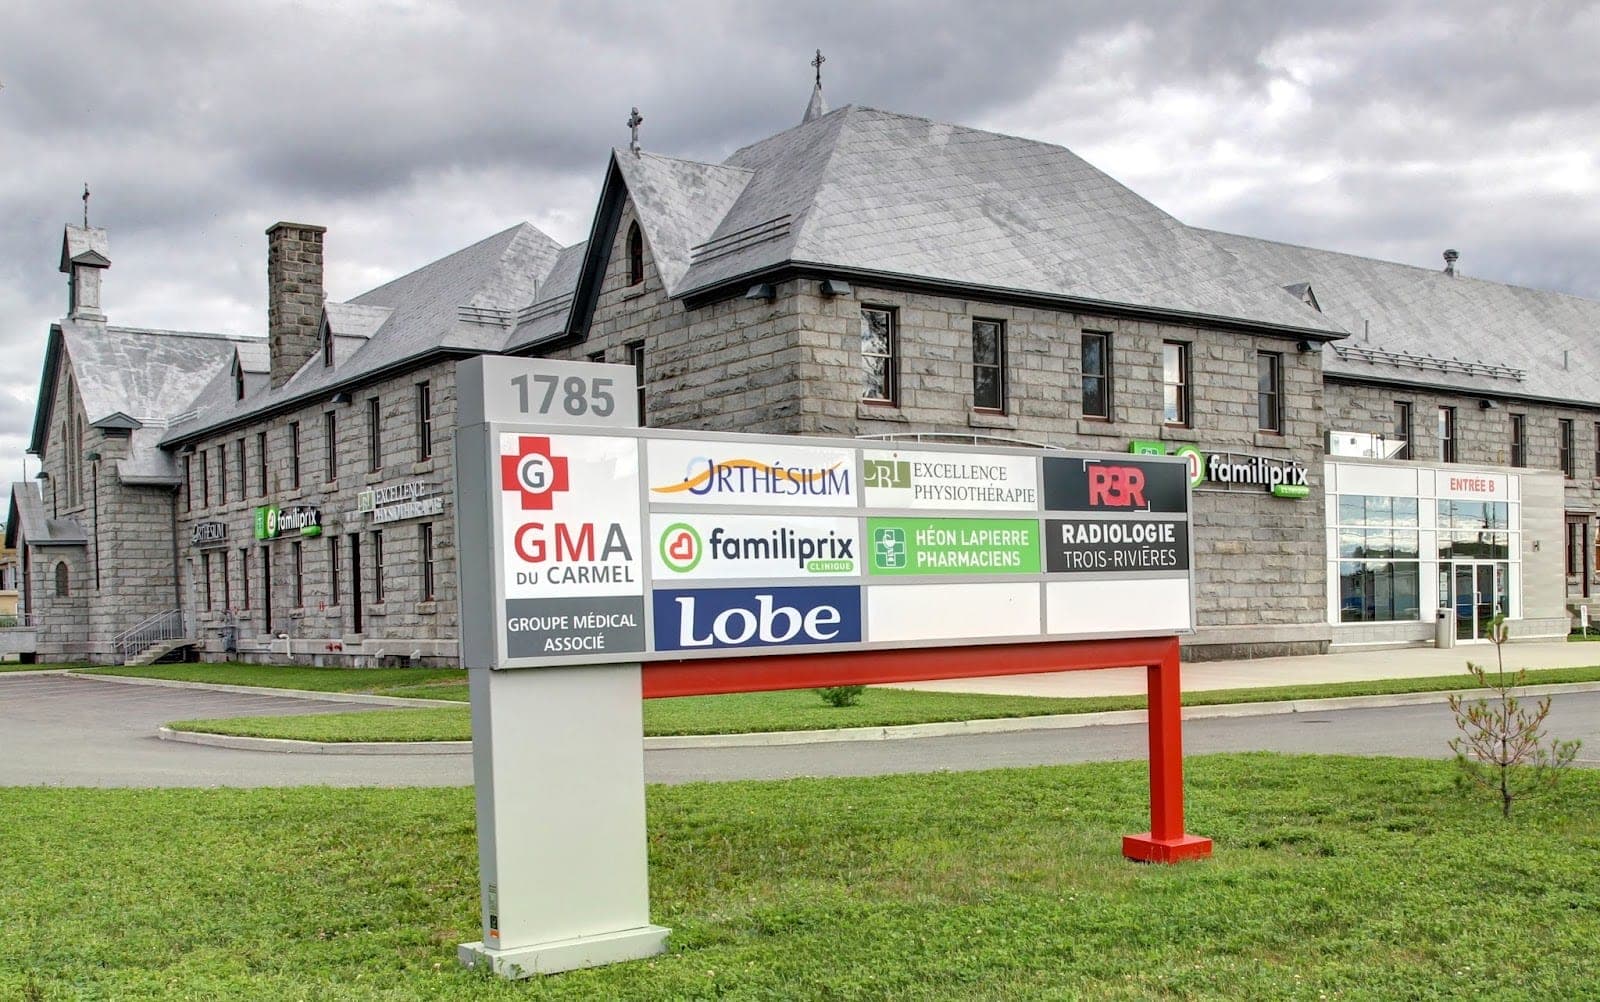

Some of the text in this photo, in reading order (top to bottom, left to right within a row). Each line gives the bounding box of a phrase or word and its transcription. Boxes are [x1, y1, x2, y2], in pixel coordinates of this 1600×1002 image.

[511, 374, 615, 417] 1785
[522, 459, 545, 489] G
[684, 456, 850, 496] ORTHÉSIUM
[913, 462, 1008, 481] EXCELLENCE
[1209, 455, 1309, 492] familiprix
[914, 483, 1036, 503] PHYSIOTHÉRAPIE
[1450, 476, 1495, 492] ENTRÉE B
[278, 505, 317, 533] familiprix
[514, 522, 633, 563] GMA
[916, 526, 1029, 546] HÉON LAPIERRE
[1062, 523, 1175, 544] RADIOLOGIE
[709, 528, 854, 569] familiprix
[809, 563, 851, 571] CLINIQUE
[917, 551, 1021, 568] PHARMACIENS
[517, 565, 635, 585] DU CARMEL
[508, 611, 637, 632] GROUPE MÉDICAL
[543, 632, 605, 652] ASSOCIÉ
